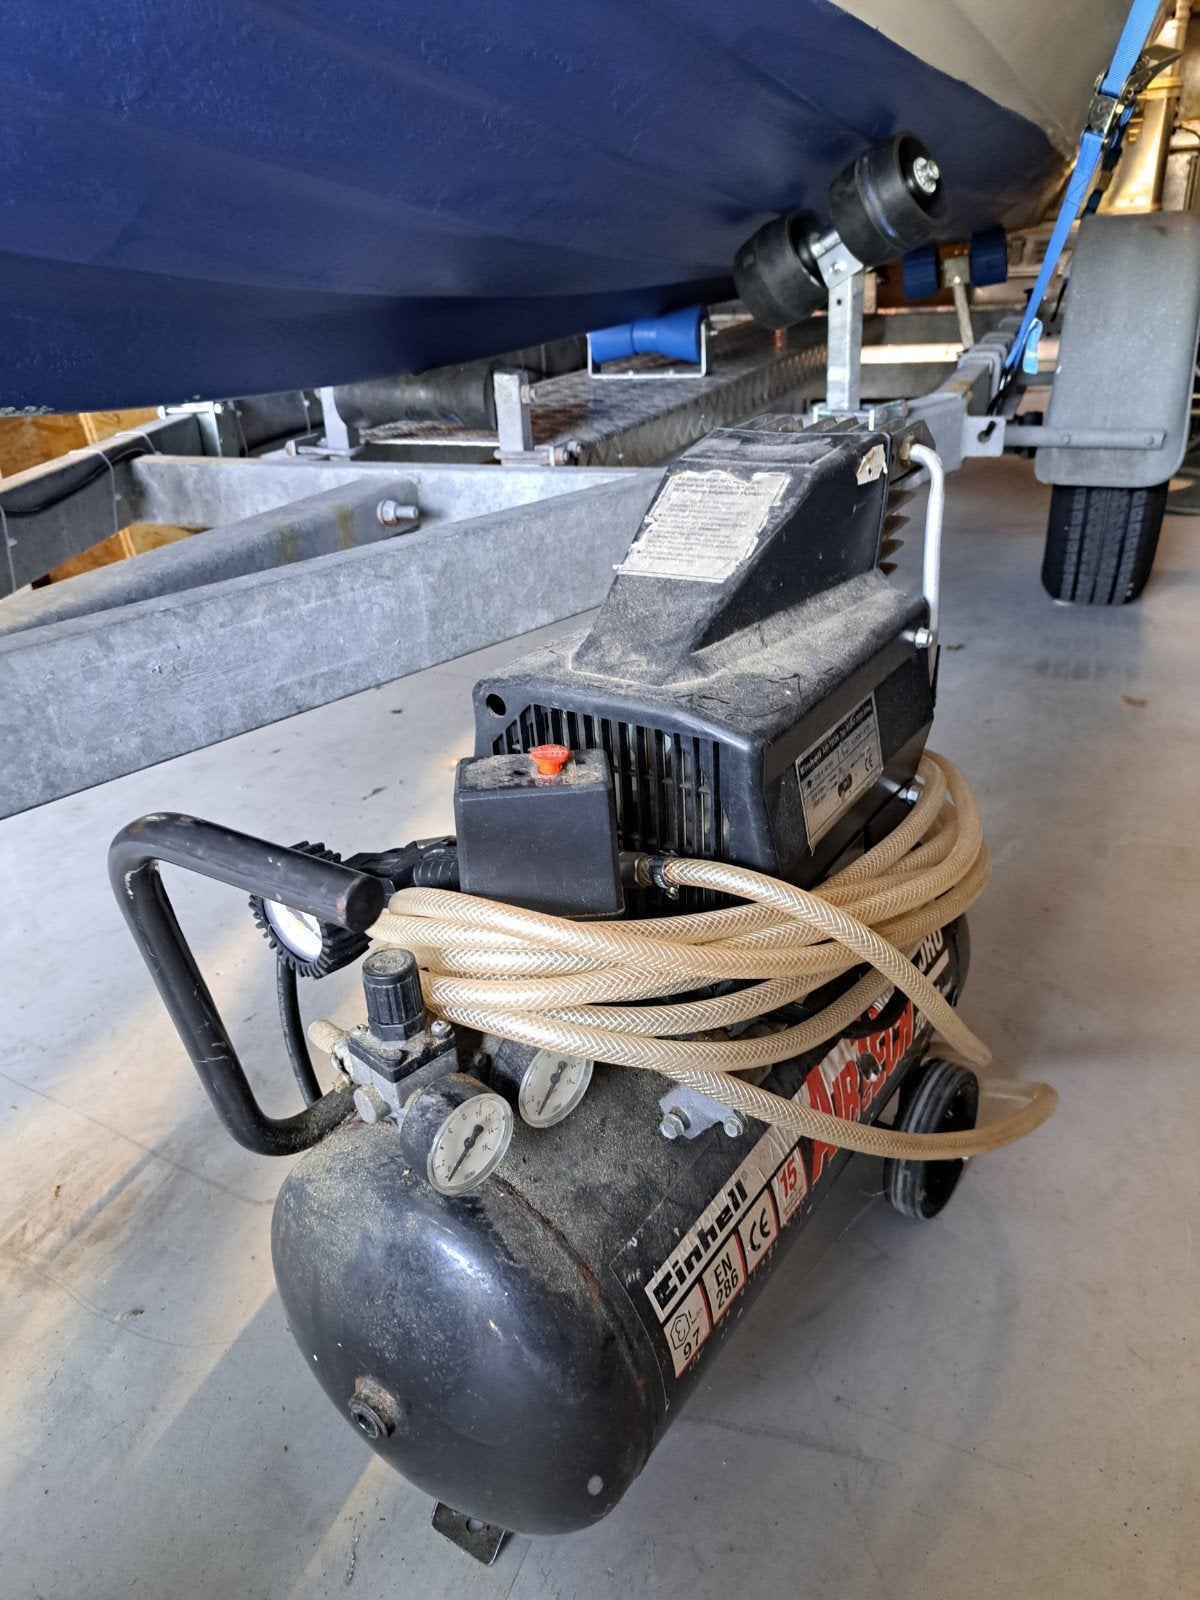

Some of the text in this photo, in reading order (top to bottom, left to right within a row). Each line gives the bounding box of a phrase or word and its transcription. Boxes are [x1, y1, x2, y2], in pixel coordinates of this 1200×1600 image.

[780, 1155, 797, 1198] 15
[652, 1179, 749, 1311] Einhell
[713, 1252, 733, 1288] EN
[716, 1268, 739, 1310] 286
[683, 1326, 700, 1361] 97
